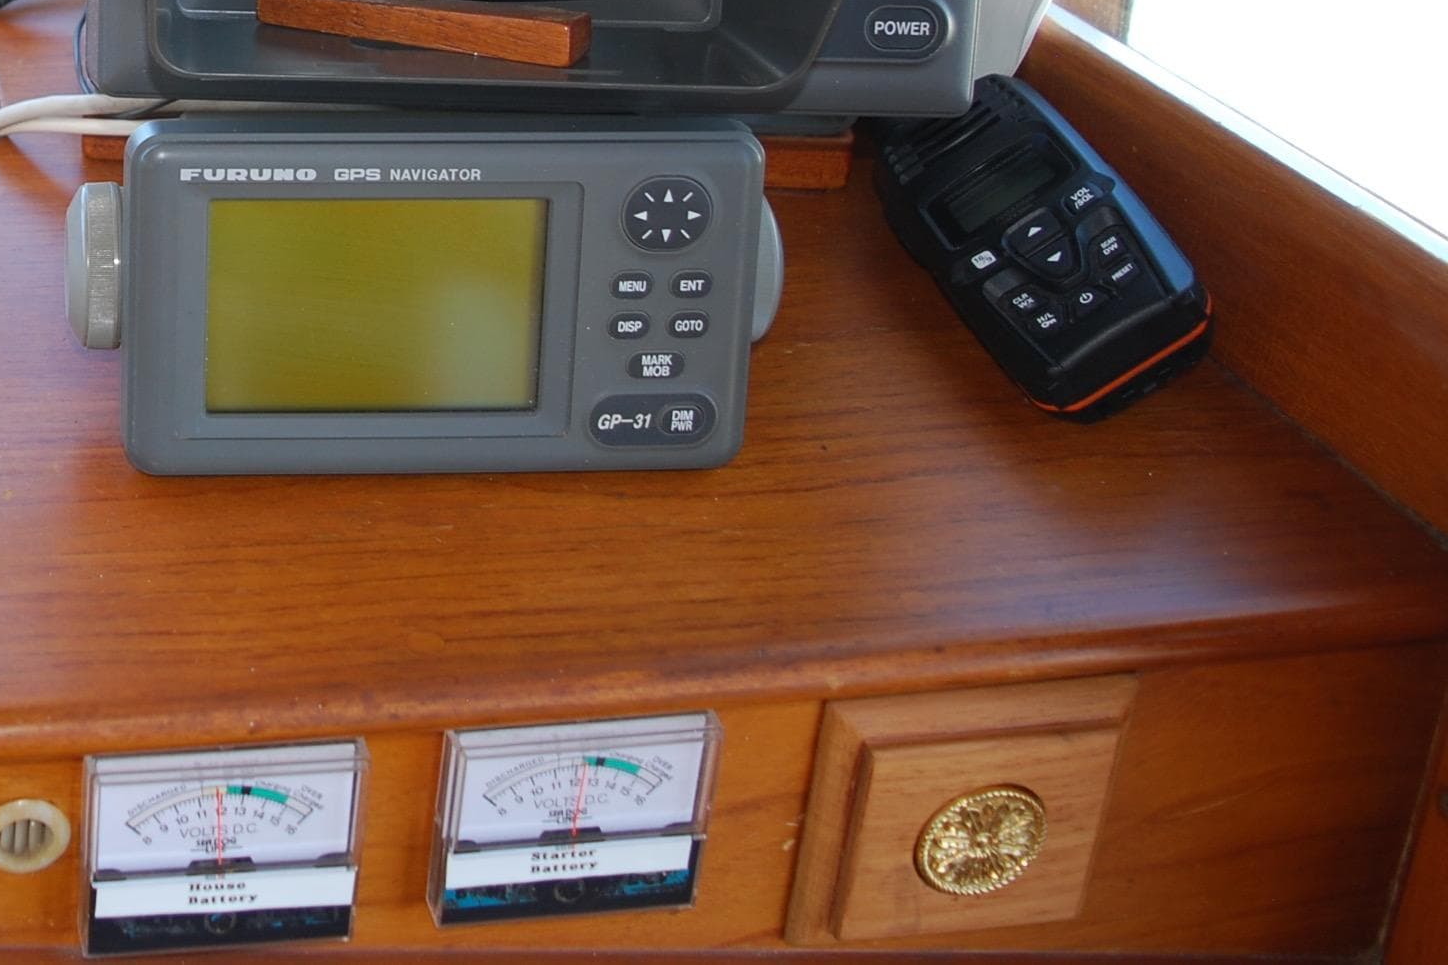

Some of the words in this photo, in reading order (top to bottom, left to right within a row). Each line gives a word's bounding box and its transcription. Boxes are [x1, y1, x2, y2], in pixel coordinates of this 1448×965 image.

[874, 22, 930, 35] POWER
[180, 168, 317, 181] FURUNO
[334, 168, 381, 181] GPS
[390, 168, 481, 181] NAVIGATOR
[1070, 187, 1090, 201] VOL
[618, 281, 647, 292] MENU
[679, 280, 704, 291] ENT
[617, 321, 642, 332] DISP
[675, 320, 703, 331] GOTO
[642, 355, 672, 365] MARK
[643, 366, 670, 377] MOB
[672, 410, 694, 421] DIM
[597, 413, 652, 430] GP-31
[671, 421, 693, 432] PWR
[531, 849, 597, 860] Starter
[531, 862, 598, 874] Battery
[188, 894, 258, 904] Battery
